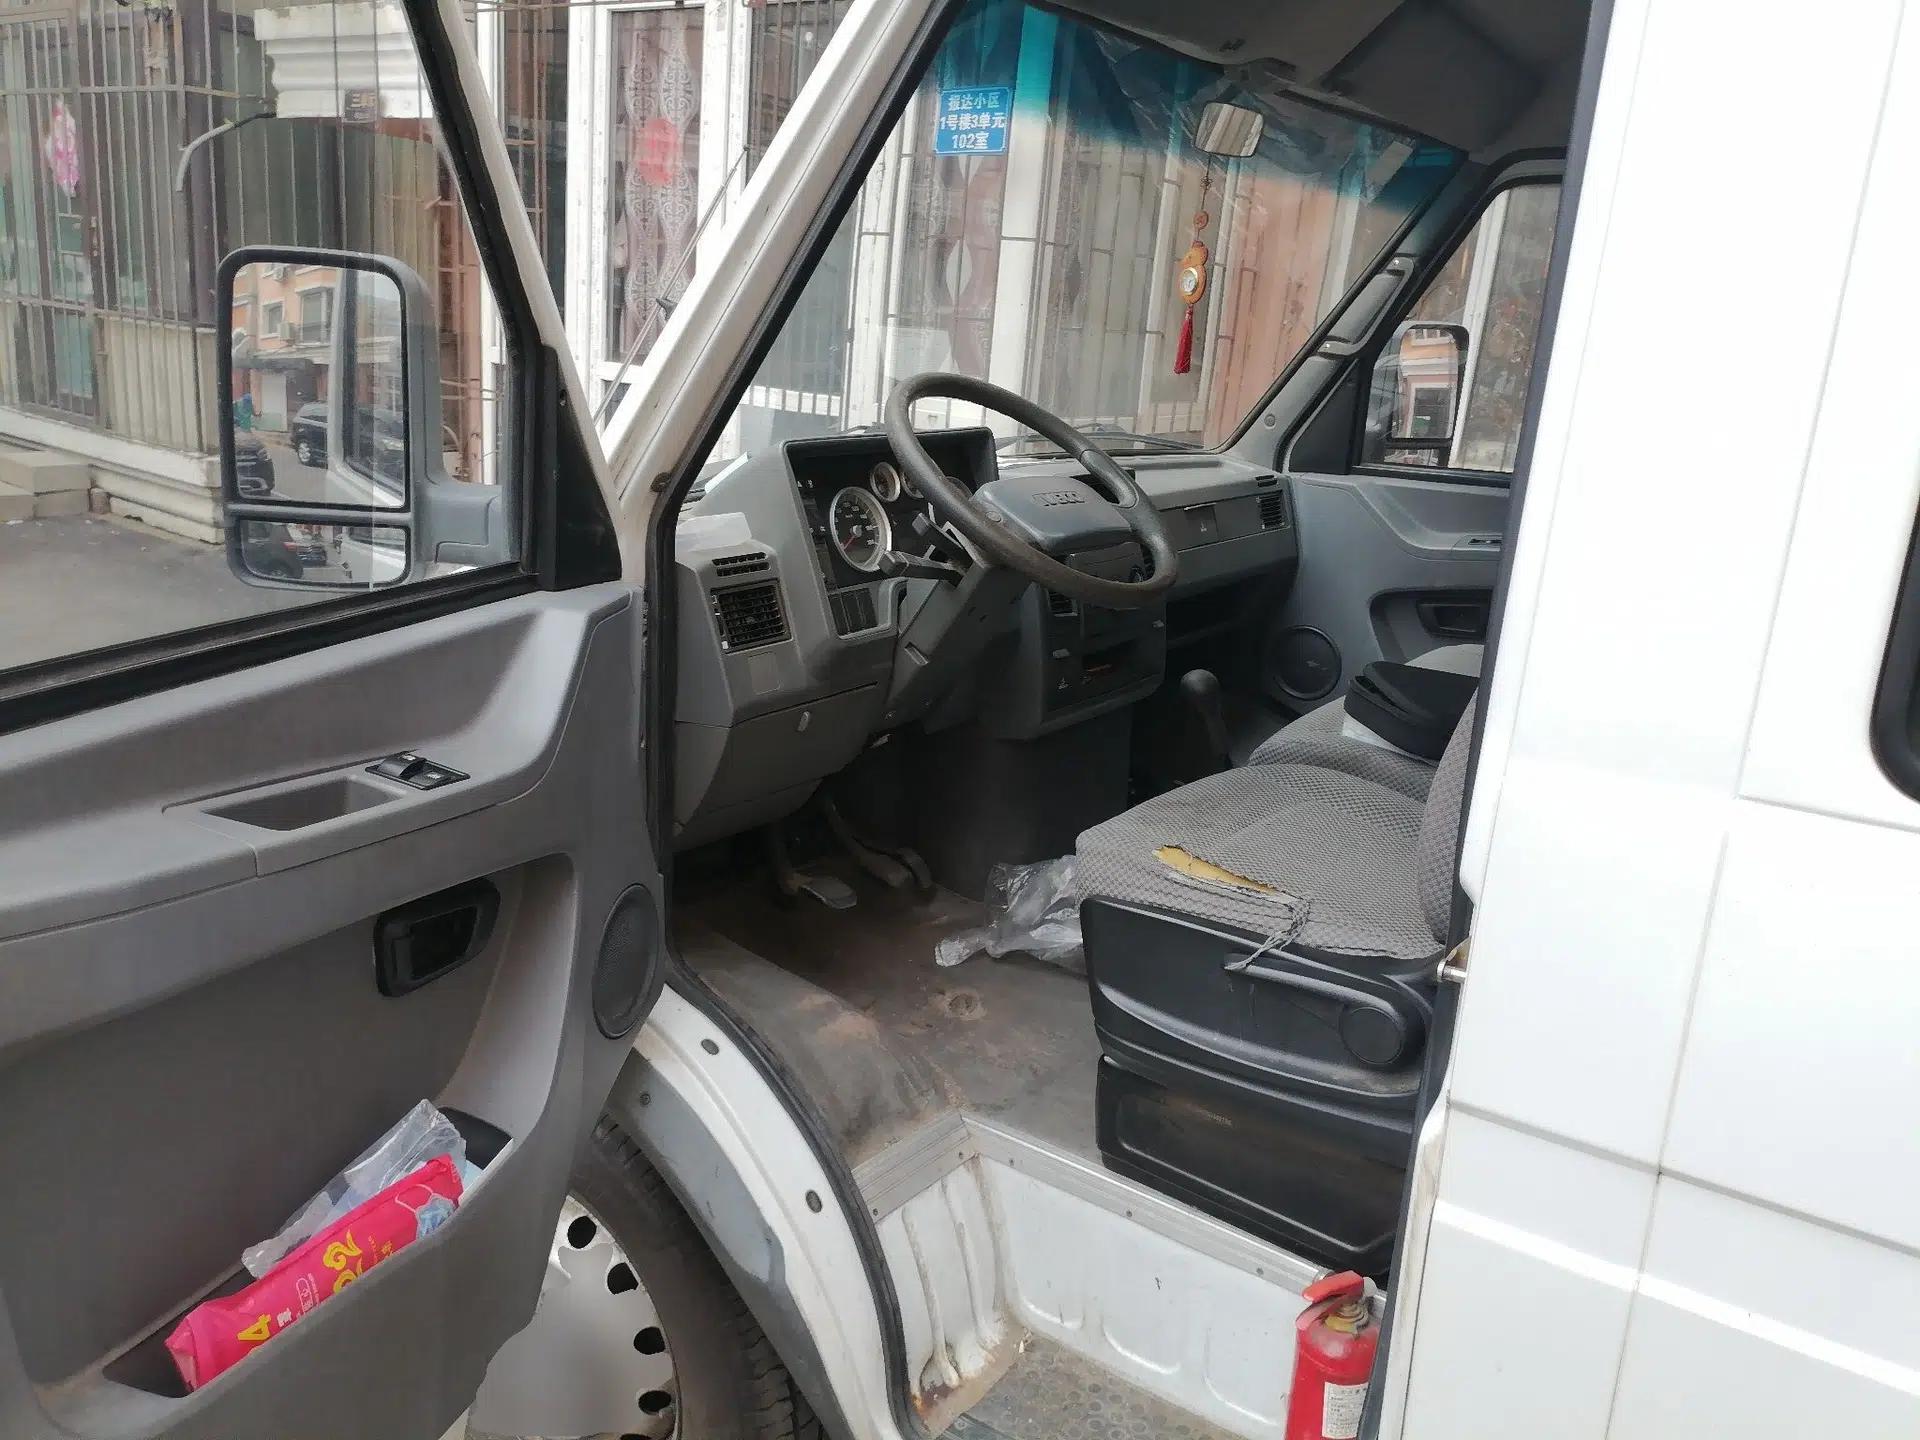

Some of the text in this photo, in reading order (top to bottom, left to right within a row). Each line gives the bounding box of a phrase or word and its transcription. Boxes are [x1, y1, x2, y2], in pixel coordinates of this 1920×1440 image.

[940, 111, 1006, 131] 1号楼3单元
[952, 131, 989, 149] 102室
